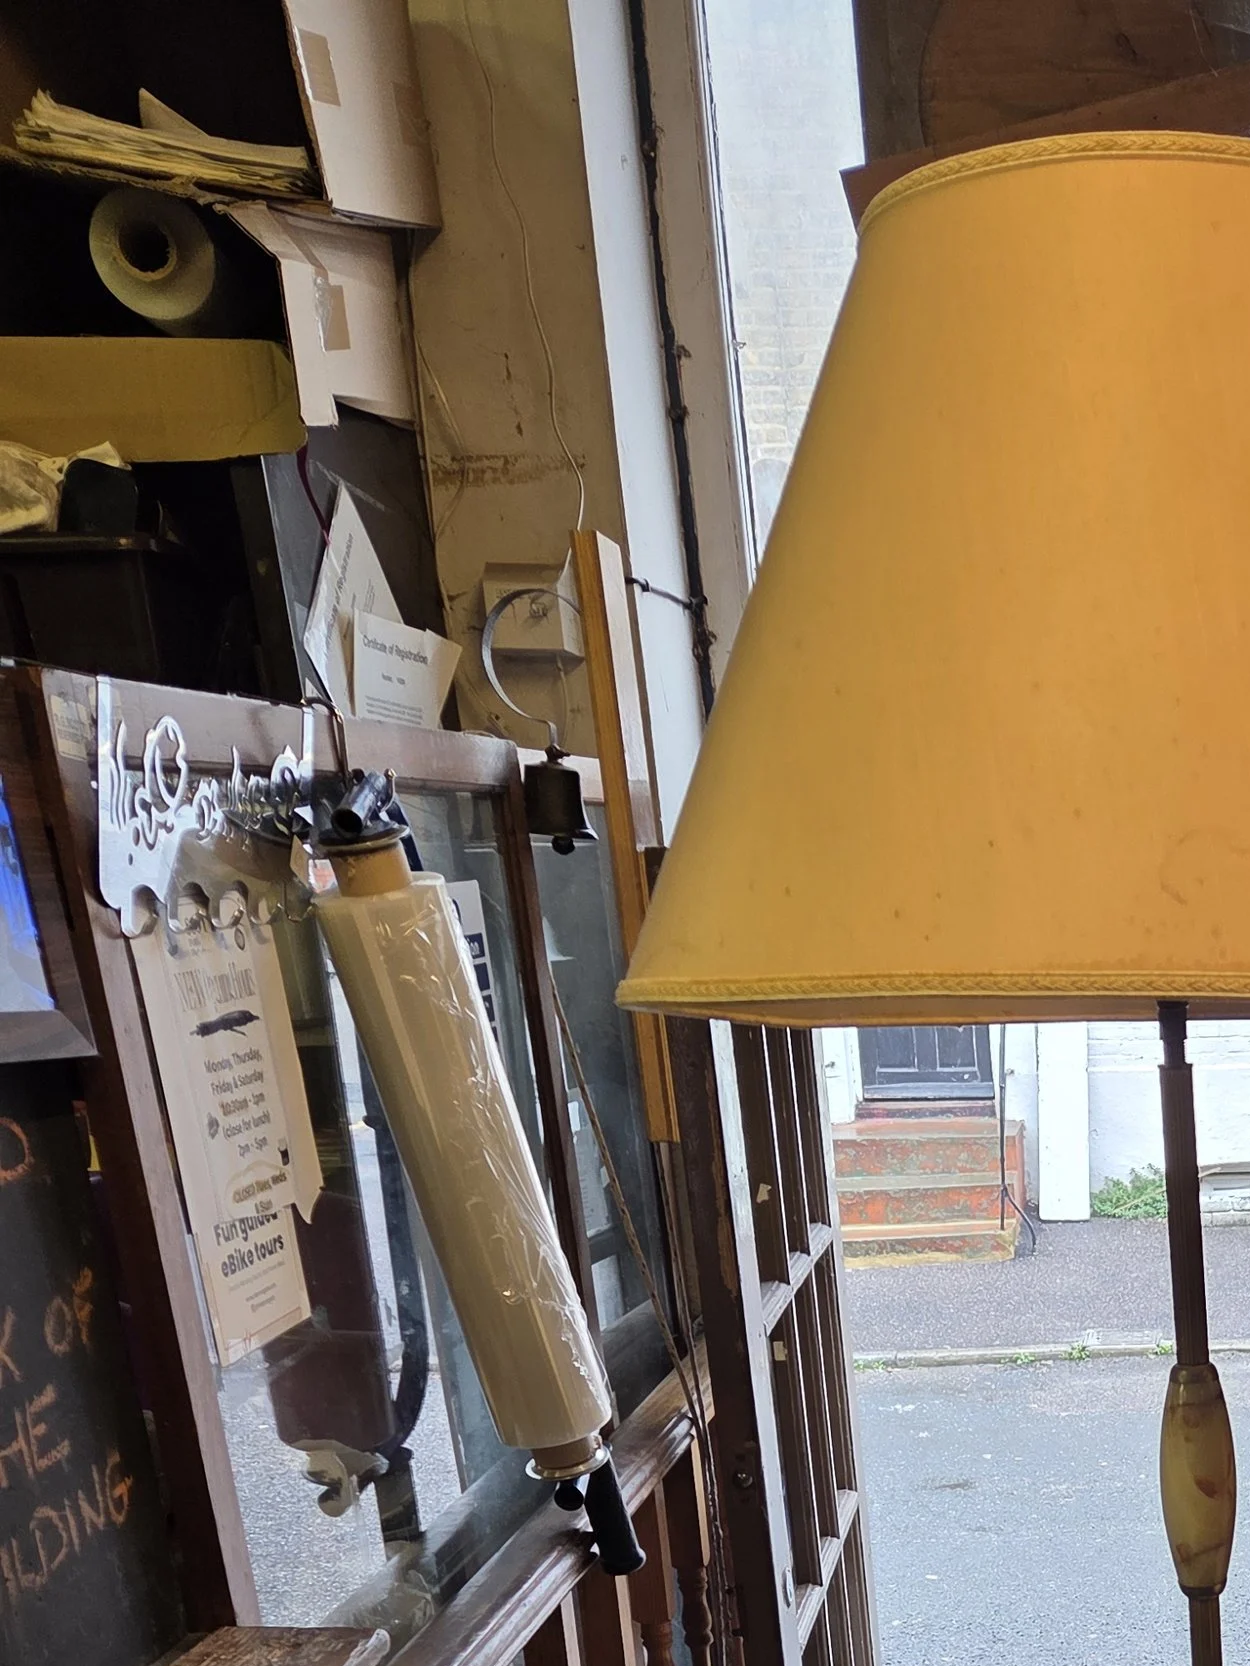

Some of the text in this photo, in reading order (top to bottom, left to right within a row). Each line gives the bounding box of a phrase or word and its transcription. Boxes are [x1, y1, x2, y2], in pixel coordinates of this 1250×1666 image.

[395, 644, 429, 666] Registration
[173, 968, 206, 1012] NEW
[204, 1047, 262, 1074] Monday, Thursday,
[210, 1079, 232, 1096] Friday
[238, 1069, 264, 1088] Saturday
[252, 1092, 265, 1108] 1pm
[222, 1110, 271, 1140] (close for lunch)
[237, 1143, 250, 1158] 2pm
[254, 1136, 268, 1152] 5pm
[232, 1182, 255, 1204] CLOSED
[260, 1200, 274, 1214] Sun
[213, 1220, 239, 1246] Fun
[221, 1247, 254, 1278] eBike
[256, 1234, 284, 1262] tours
